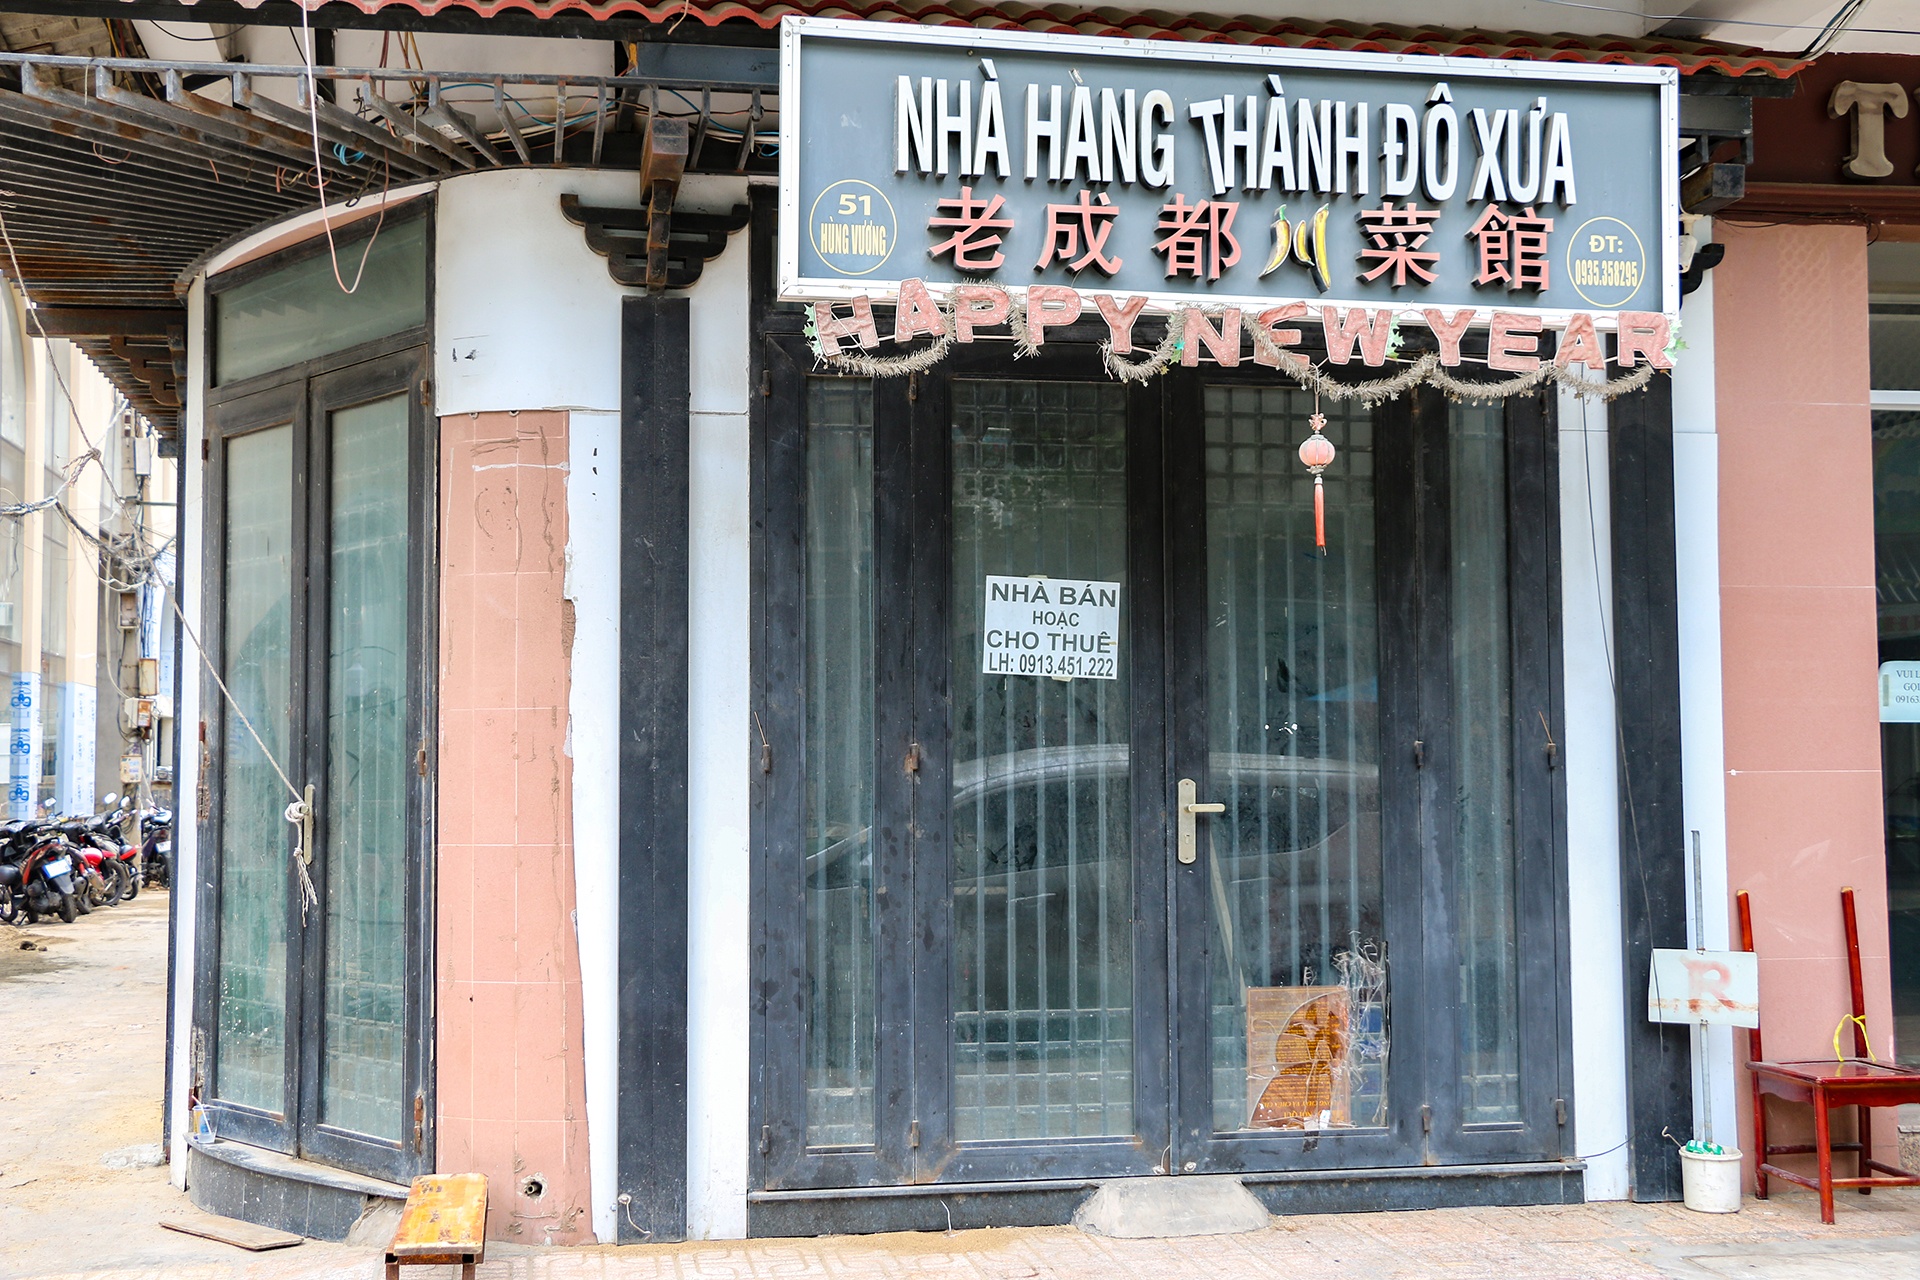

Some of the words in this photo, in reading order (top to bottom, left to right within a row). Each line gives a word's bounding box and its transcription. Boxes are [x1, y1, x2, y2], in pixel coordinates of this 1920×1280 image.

[896, 58, 1011, 179] NHÀ
[1023, 69, 1175, 188] HÀNG
[1188, 74, 1369, 197] THÀNH
[1378, 82, 1459, 201] ĐÔ
[1467, 97, 1576, 205] XƯA
[1828, 80, 1920, 178] T
[838, 193, 871, 216] 51
[820, 215, 849, 255] HÙNG
[1588, 234, 1623, 253] ĐT:
[1575, 259, 1638, 287] 0935.358295
[812, 278, 1149, 357] HAPPY
[1180, 301, 1395, 368] NEW
[1422, 308, 1675, 372] YEAR
[991, 581, 1050, 604] NHÀ
[1059, 584, 1116, 608] BÁN
[986, 629, 1039, 650] CHO
[1047, 631, 1111, 653] THUÊ
[989, 652, 1014, 672] LH:
[1019, 653, 1114, 677] 0913.451.222
[1896, 670, 1913, 678] VUI
